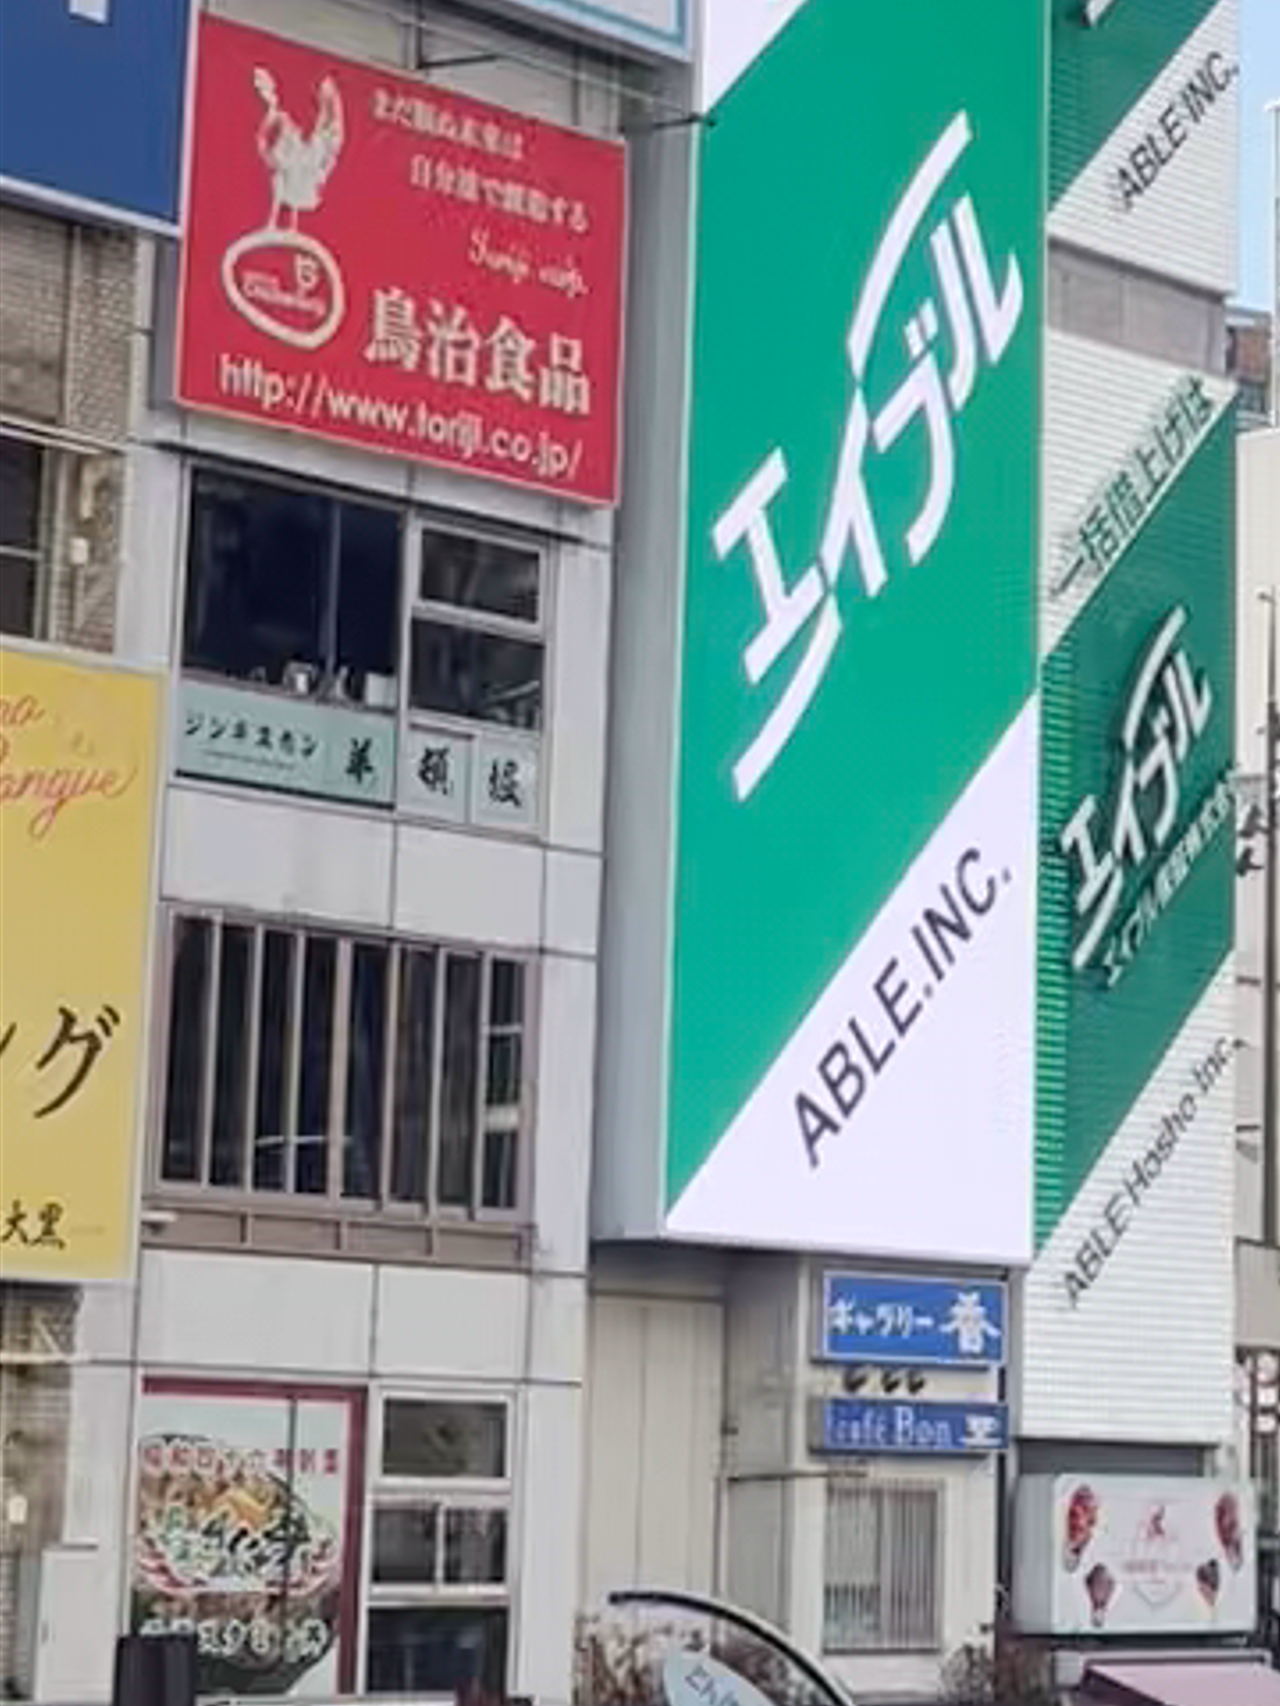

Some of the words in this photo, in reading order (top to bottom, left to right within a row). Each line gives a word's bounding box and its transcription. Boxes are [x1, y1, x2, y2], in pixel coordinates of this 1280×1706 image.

[1114, 103, 1188, 216] ABLE
[364, 287, 591, 416] 鳥治食品
[219, 353, 582, 480] http://www.toriji.co.jp/
[712, 110, 1024, 803] エイブル
[1062, 604, 1213, 972] エイブル
[1062, 1190, 1133, 1312] ABLE
[829, 1294, 935, 1340] ギャラリー
